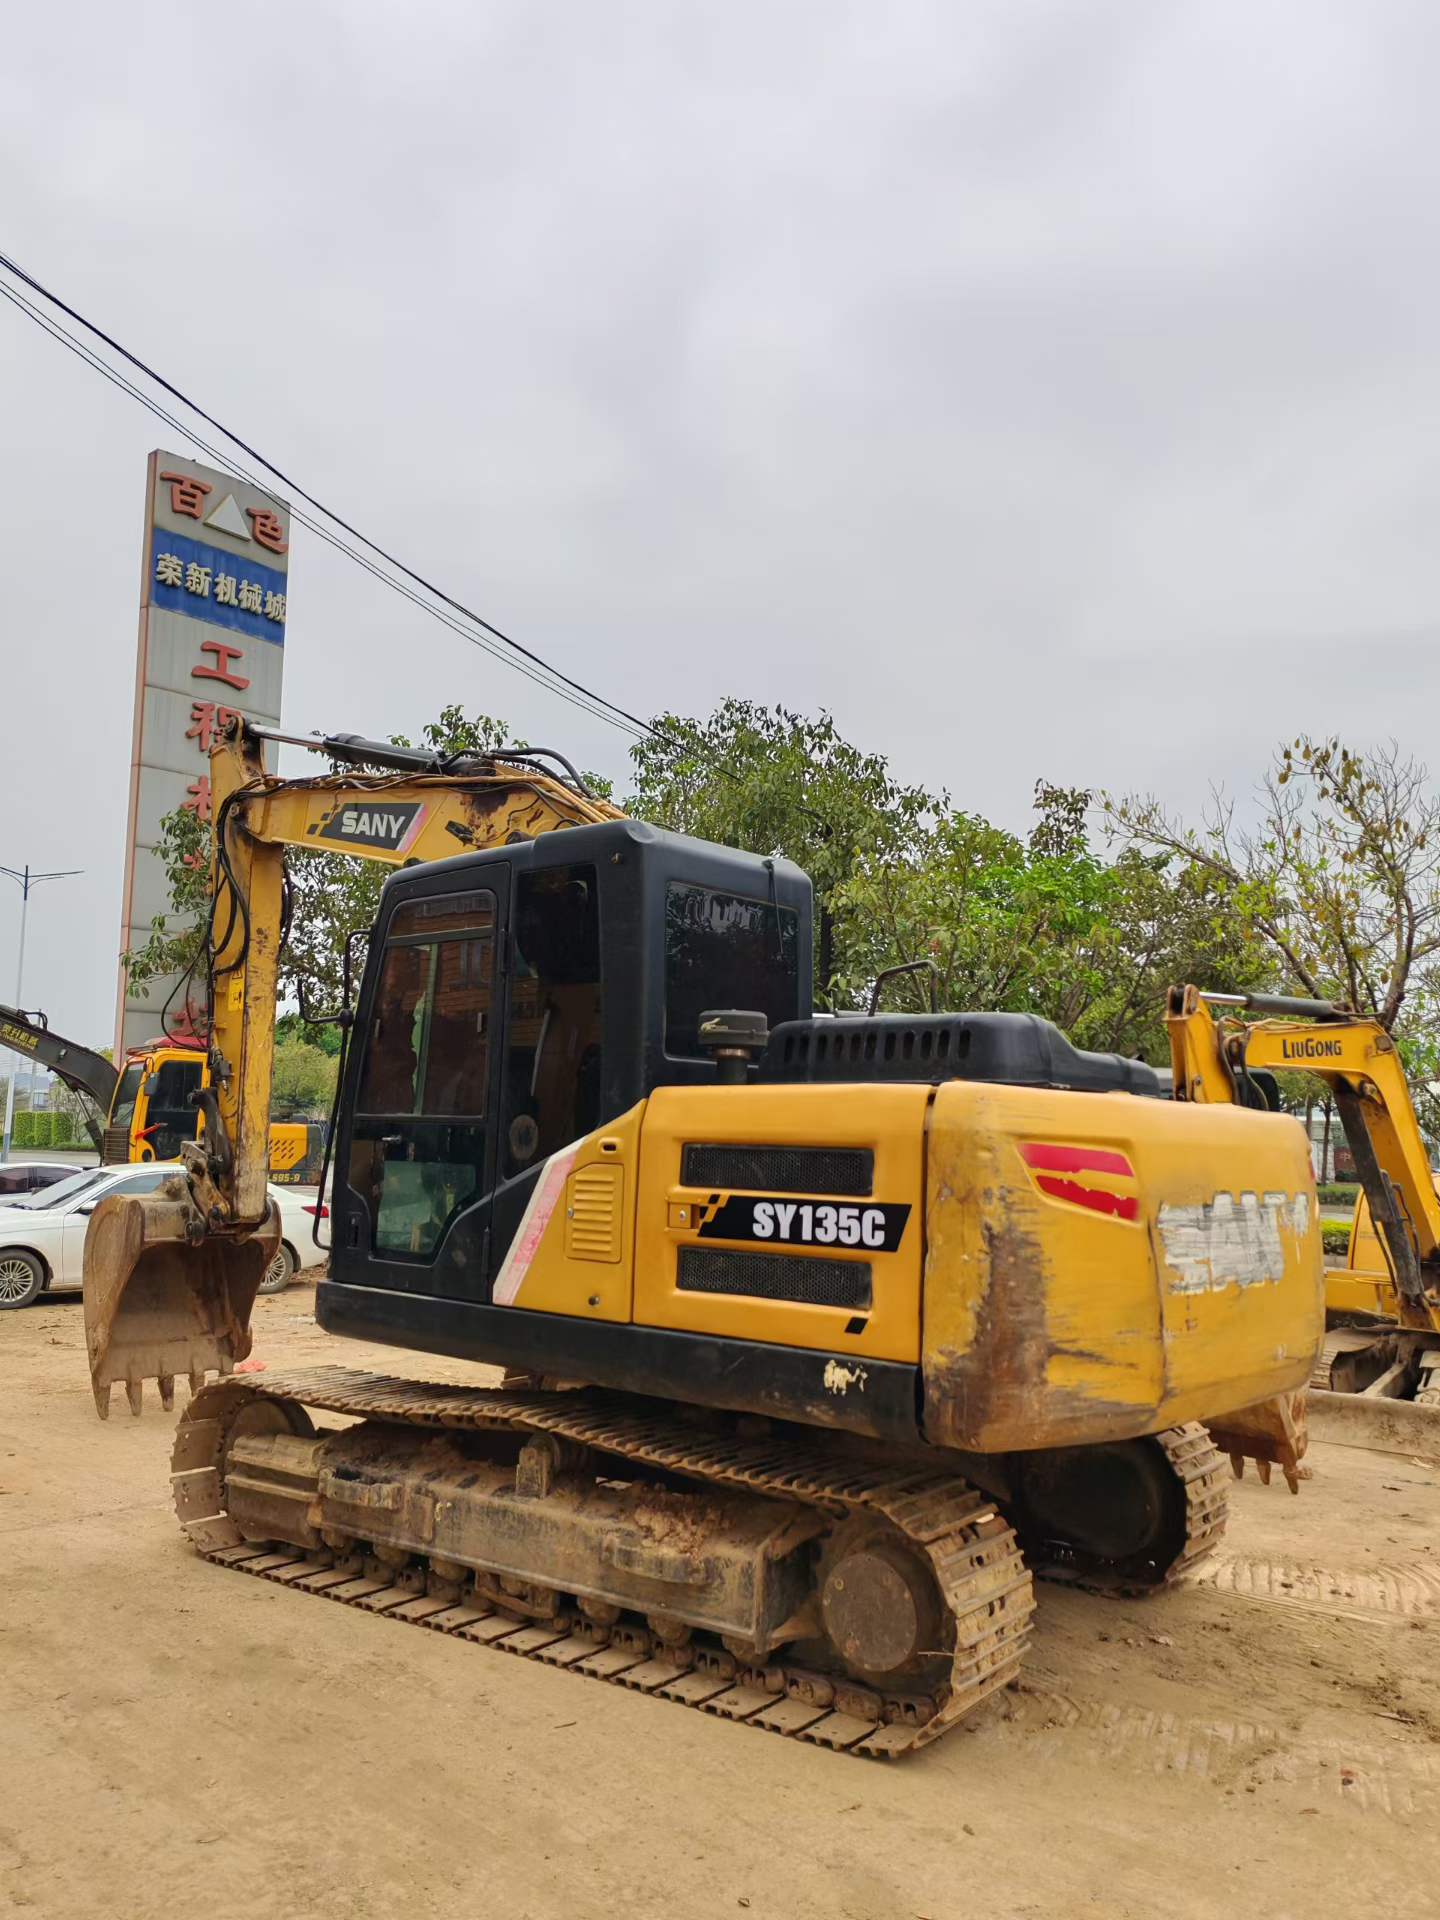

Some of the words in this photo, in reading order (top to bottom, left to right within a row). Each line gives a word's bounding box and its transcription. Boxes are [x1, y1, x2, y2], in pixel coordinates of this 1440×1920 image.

[156, 553, 288, 625] 荣新机械城
[341, 810, 406, 839] SANY
[752, 1201, 886, 1247] SY135C
